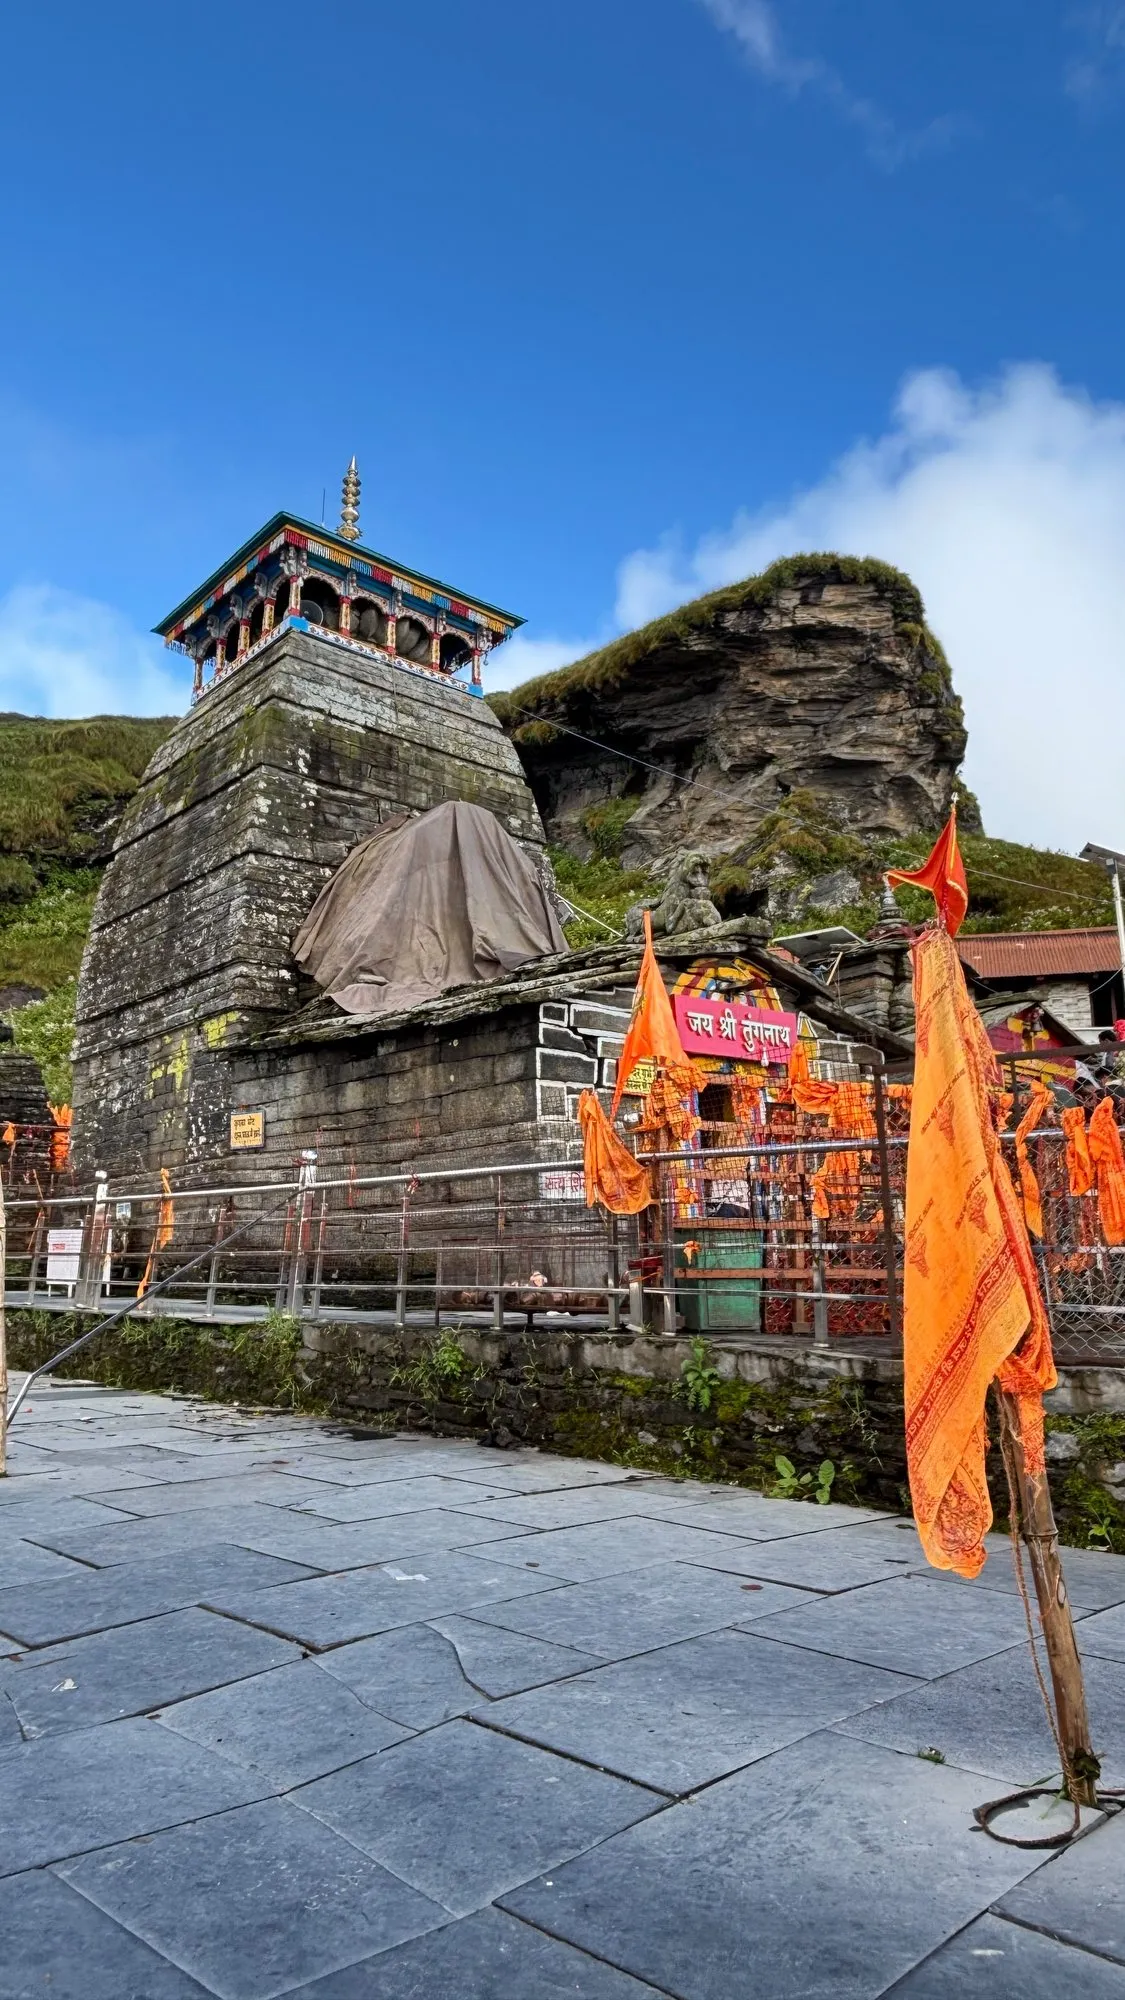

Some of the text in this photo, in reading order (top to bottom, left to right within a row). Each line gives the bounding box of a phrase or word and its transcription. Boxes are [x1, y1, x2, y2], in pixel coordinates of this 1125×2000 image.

[686, 1008, 791, 1052] जय श्री तुंगनाथ
